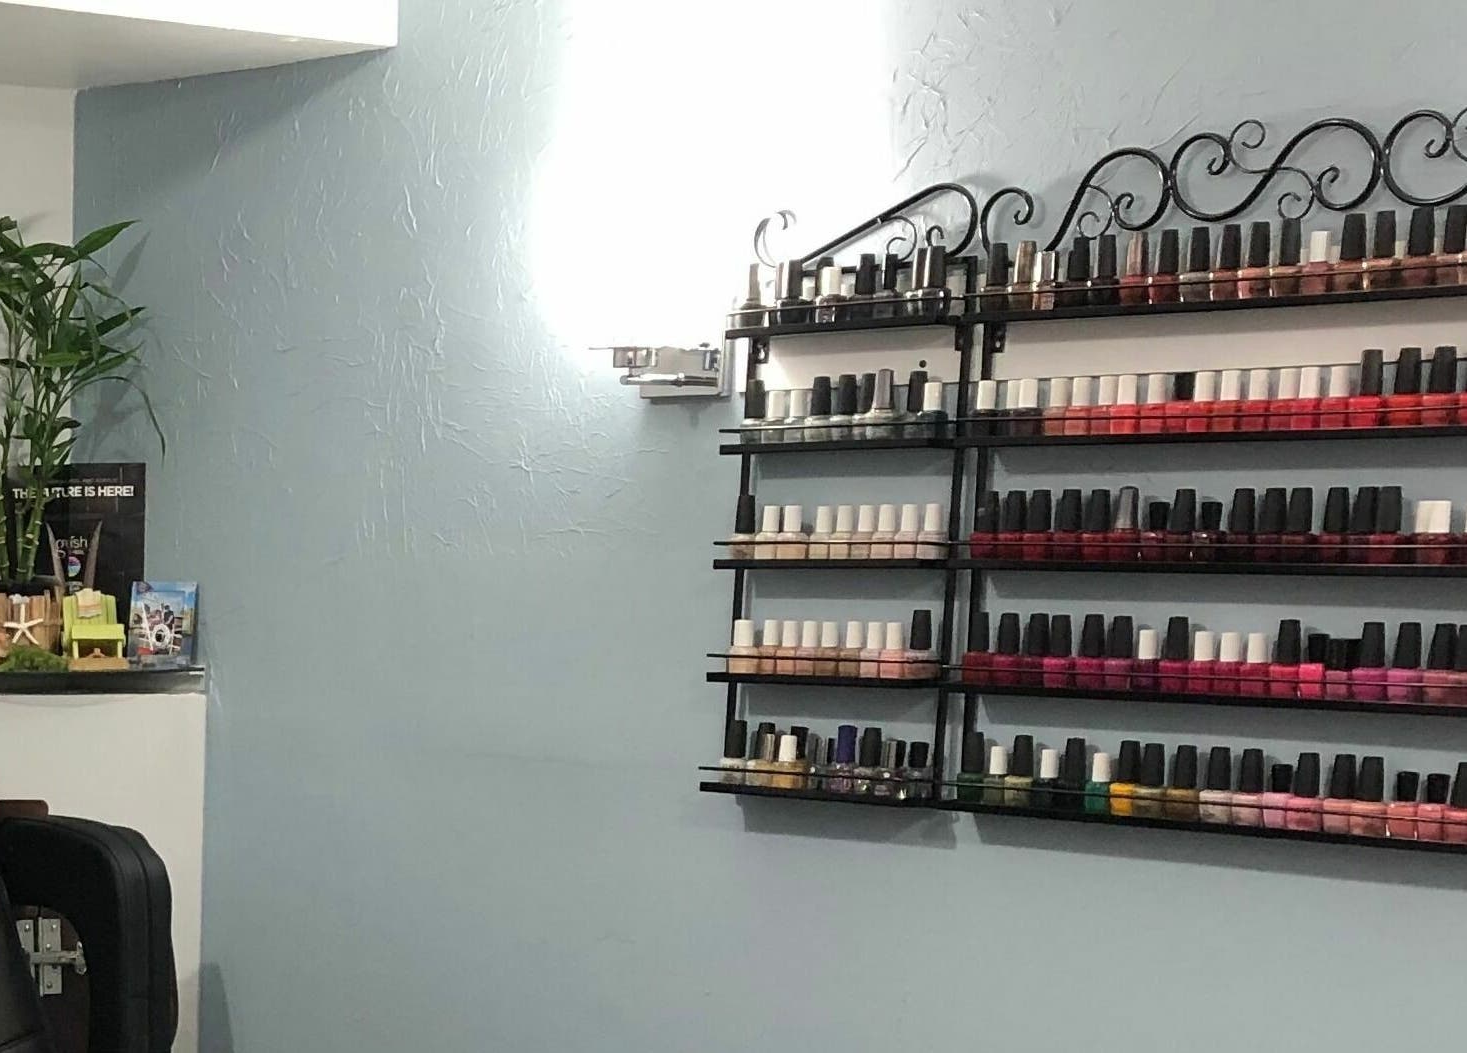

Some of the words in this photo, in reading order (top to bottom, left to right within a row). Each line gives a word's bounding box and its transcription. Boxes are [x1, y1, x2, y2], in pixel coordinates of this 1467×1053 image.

[38, 486, 83, 499] UTURE
[84, 486, 96, 498] IS
[97, 485, 135, 497] HERE!
